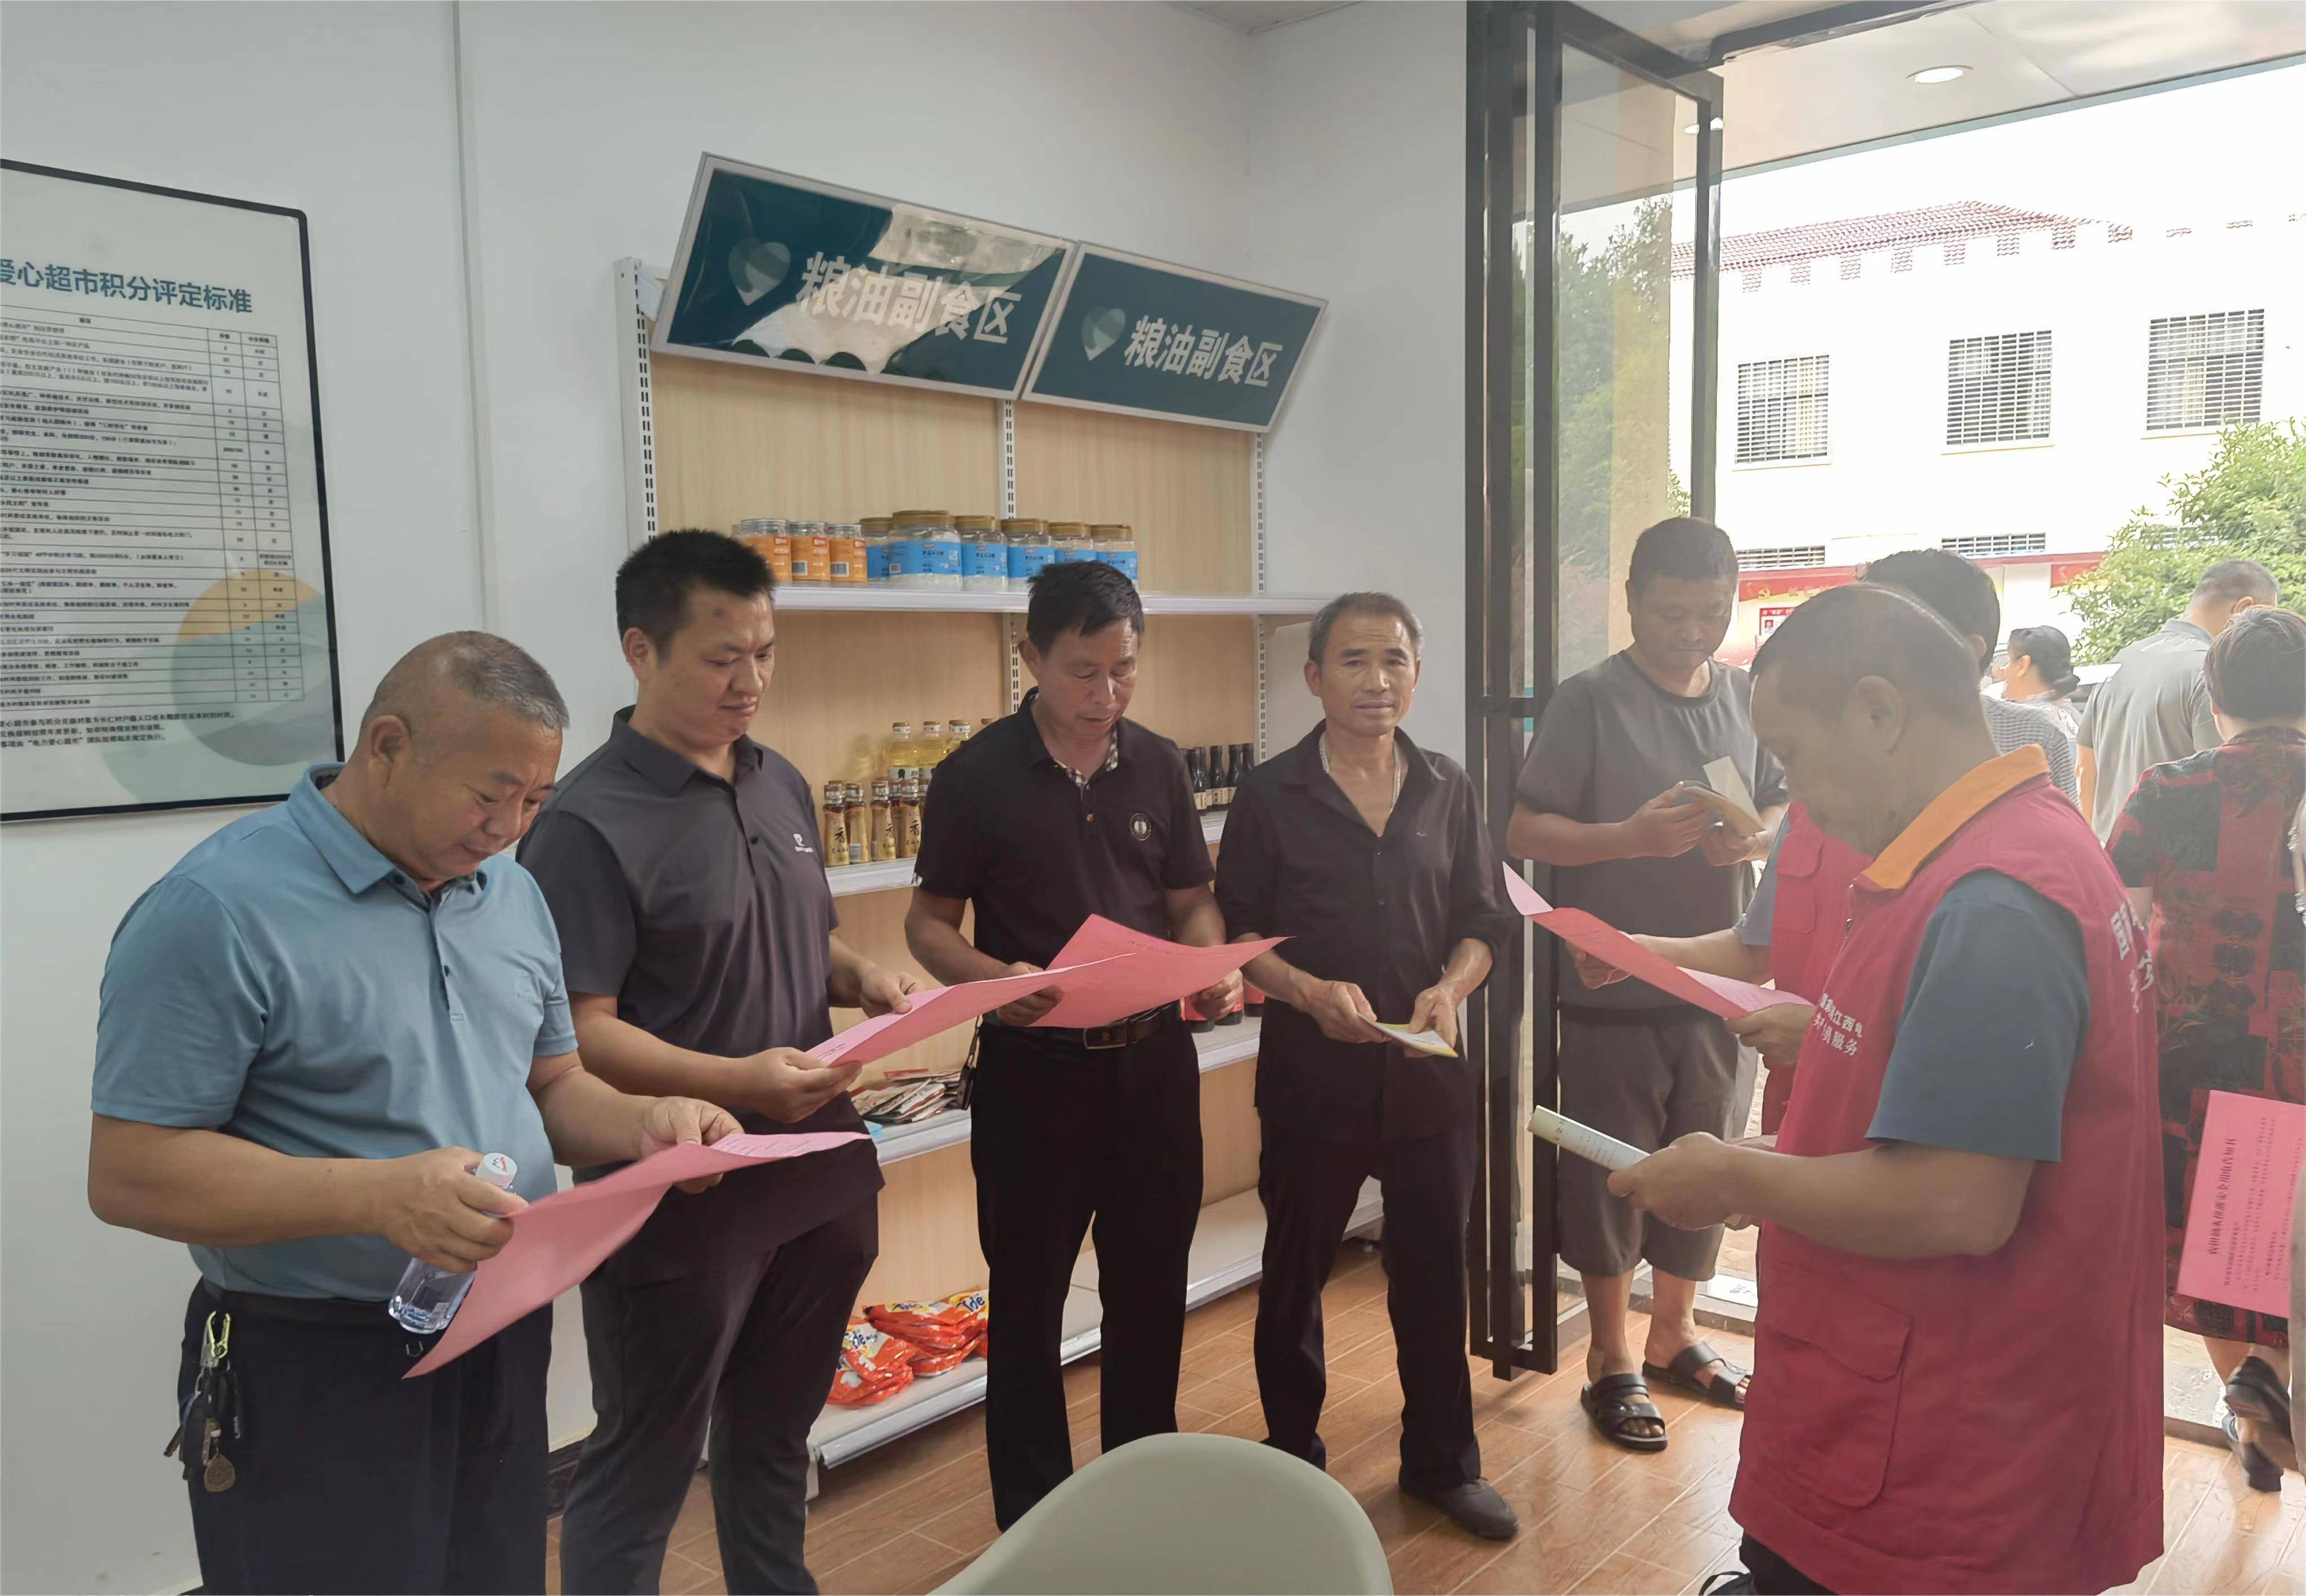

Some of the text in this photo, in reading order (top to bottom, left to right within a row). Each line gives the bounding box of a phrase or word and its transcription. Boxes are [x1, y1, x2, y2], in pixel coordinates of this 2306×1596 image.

[0, 258, 253, 313] 爱心超市积分评定标准
[796, 251, 1022, 345] 粮油副食区
[1124, 315, 1284, 387] 粮油副食区
